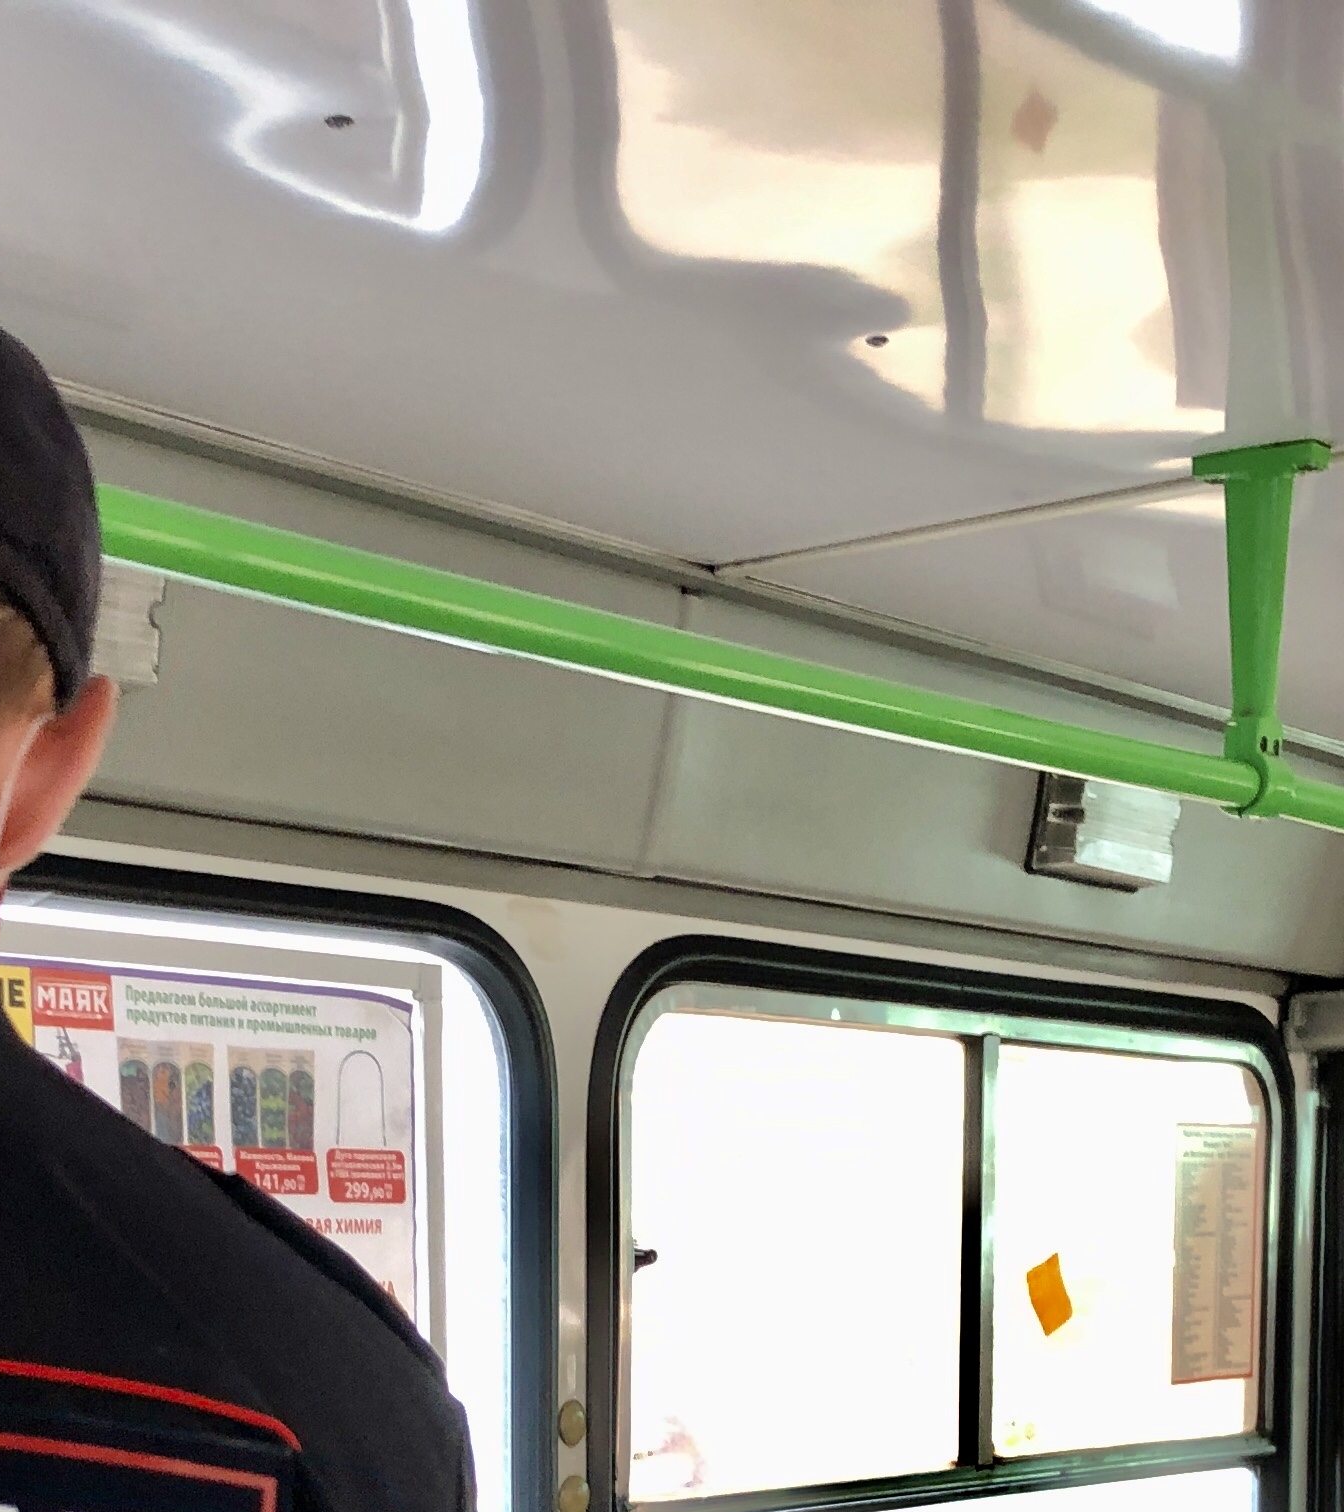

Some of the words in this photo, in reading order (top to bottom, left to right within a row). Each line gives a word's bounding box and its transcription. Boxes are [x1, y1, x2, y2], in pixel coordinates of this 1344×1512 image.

[37, 985, 109, 1013] МАЯК
[126, 984, 196, 1007] Предлагаем
[198, 991, 248, 1012] большой
[250, 999, 318, 1018] ассортимент
[127, 1007, 188, 1028] продуктов
[190, 1014, 237, 1029] питания
[238, 1018, 244, 1030] и
[246, 1018, 332, 1037] промышленных
[334, 1024, 377, 1042] товаров
[336, 1218, 383, 1235] ХИМИЯ
